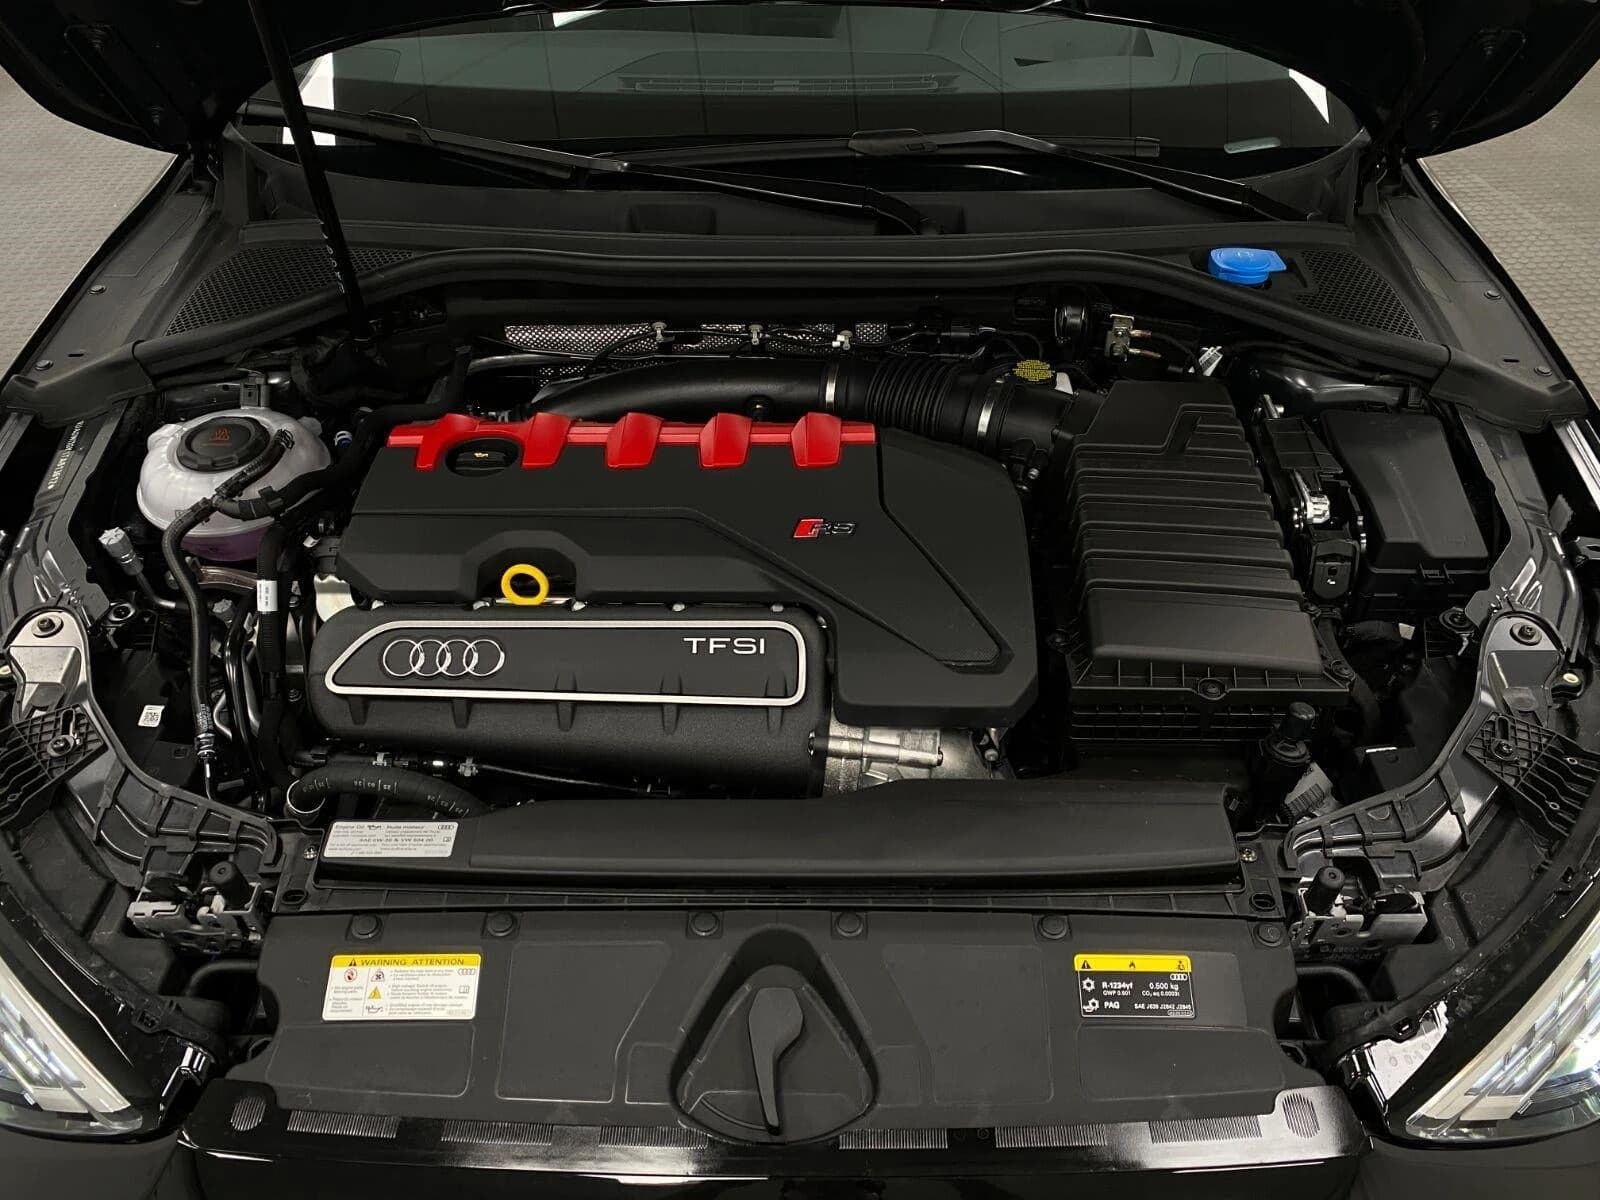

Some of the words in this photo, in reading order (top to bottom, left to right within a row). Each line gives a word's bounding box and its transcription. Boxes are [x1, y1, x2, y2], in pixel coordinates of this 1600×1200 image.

[799, 519, 856, 537] RS
[683, 637, 765, 655] TFSI
[361, 959, 407, 967] WARNING
[413, 958, 465, 966] ATTENTION
[1170, 982, 1179, 991] kg
[1104, 1001, 1120, 1009] PAG
